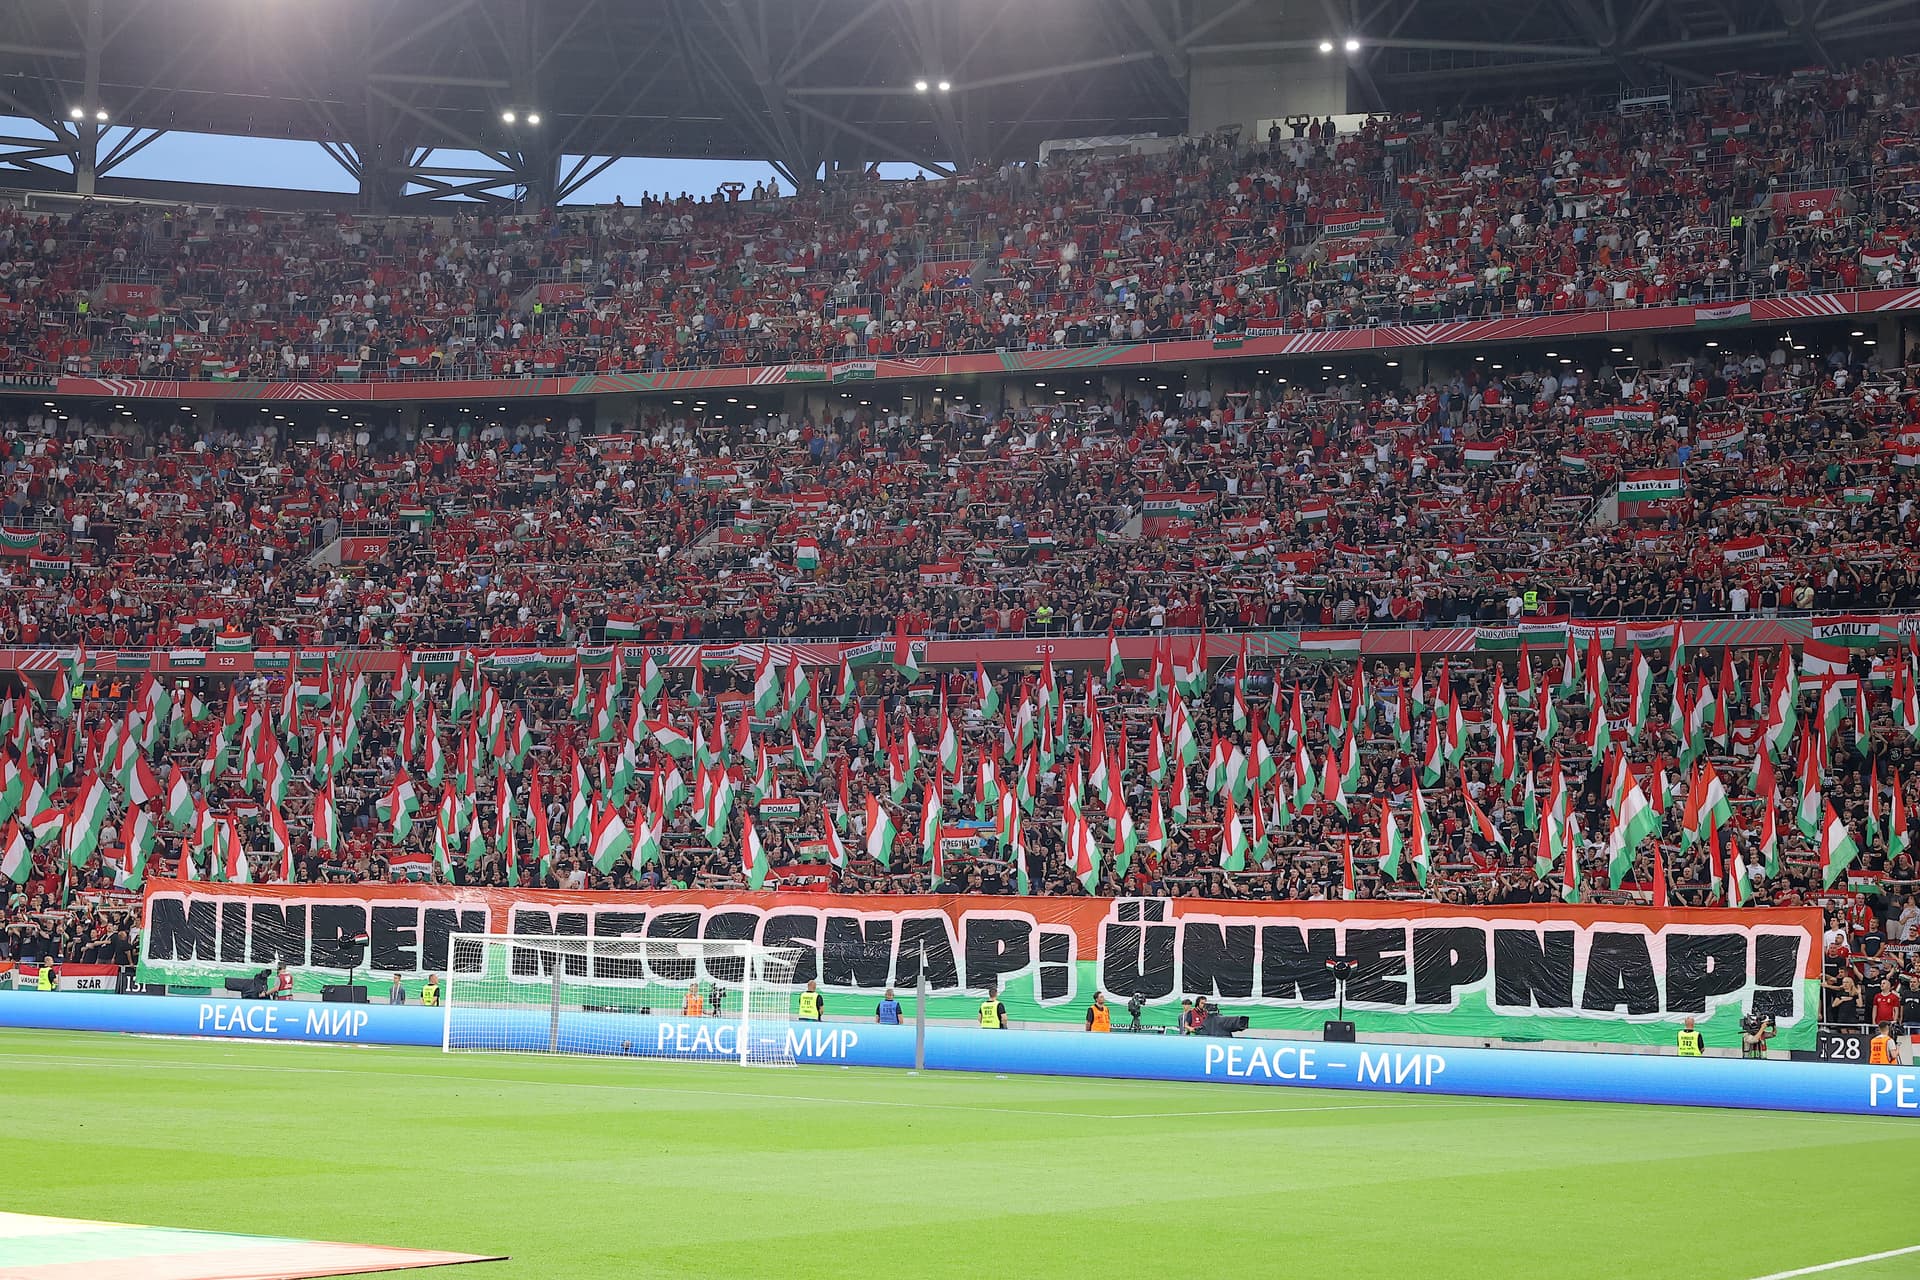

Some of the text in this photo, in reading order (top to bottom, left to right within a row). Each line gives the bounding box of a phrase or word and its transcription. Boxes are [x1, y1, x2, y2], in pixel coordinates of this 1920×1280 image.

[1327, 220, 1360, 232] MISKOLC
[364, 545, 380, 553] 233
[1820, 623, 1872, 638] KAMUT
[846, 644, 873, 658] BODAJK
[883, 641, 924, 651] MOCS
[219, 657, 235, 666] 132
[148, 898, 486, 973] MINDEN
[1102, 898, 1802, 1018] ÜNNEPNAP!
[77, 977, 102, 989] SZÁR
[199, 1004, 278, 1033] PEACE
[305, 1008, 369, 1037] МИР
[785, 1028, 859, 1058] МИР
[1205, 1044, 1317, 1080] PEACE
[1357, 1051, 1446, 1086] МИР
[1869, 1072, 1920, 1109] PE
